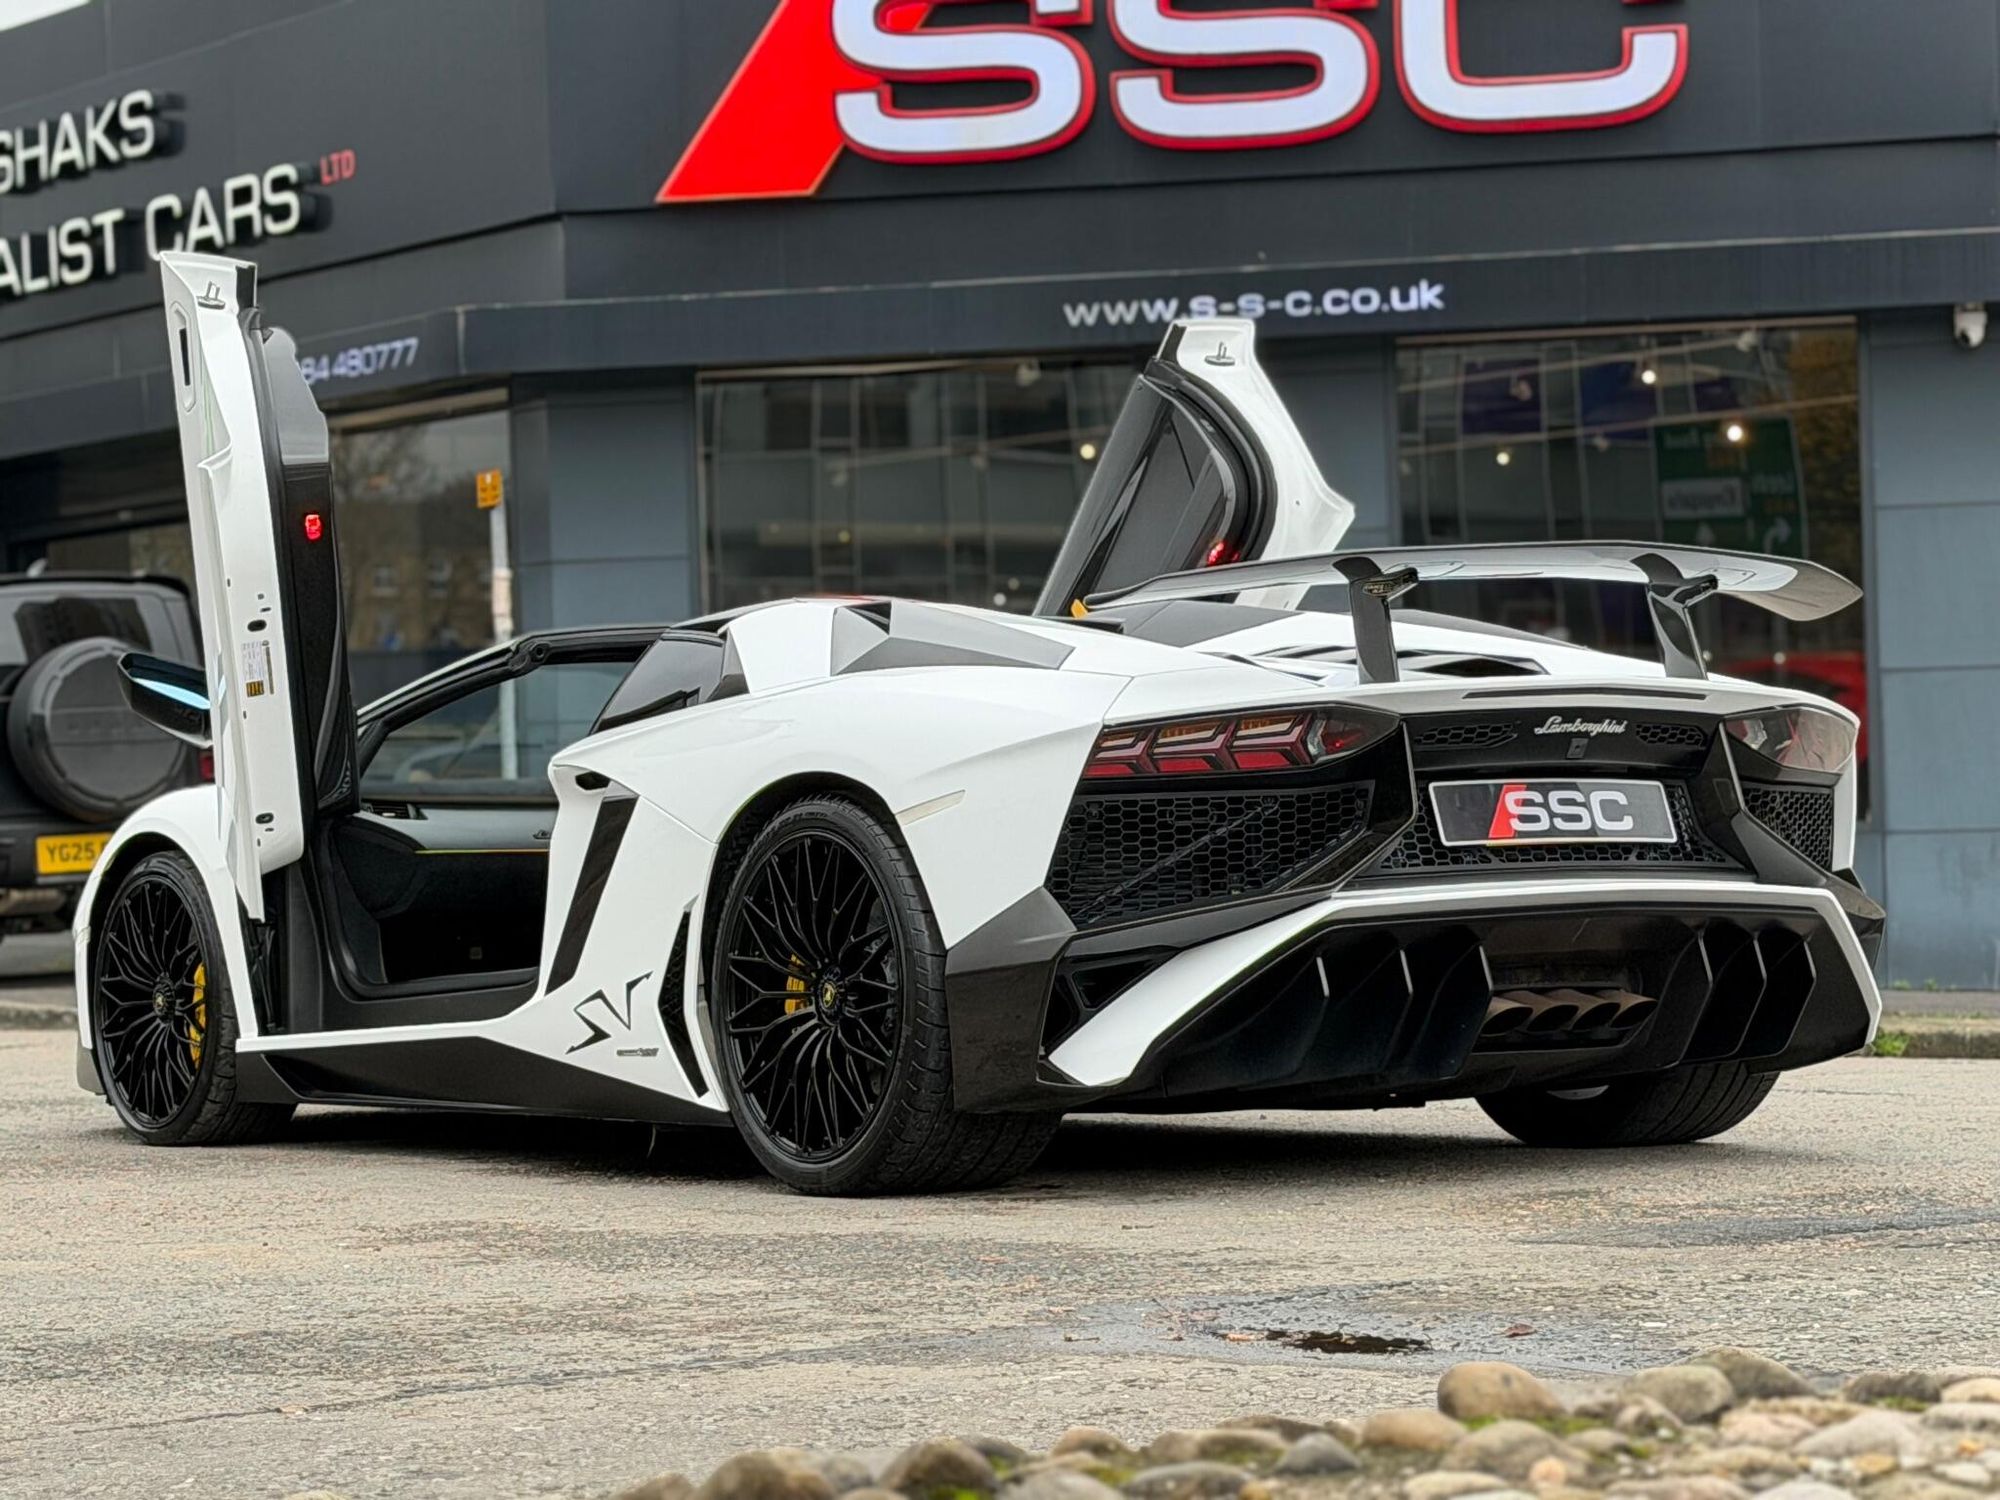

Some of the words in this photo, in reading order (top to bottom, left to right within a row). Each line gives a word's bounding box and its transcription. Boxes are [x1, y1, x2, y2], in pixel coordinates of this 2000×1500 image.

[829, 0, 1688, 163] SSC
[145, 163, 300, 261] CARS
[320, 149, 356, 185] LTD
[1063, 279, 1444, 328] www.s-s-c.co.uk
[1533, 715, 1628, 737] Lamborghini
[1504, 790, 1634, 832] SSC
[46, 843, 96, 863] YG25
[565, 970, 654, 1055] SV
